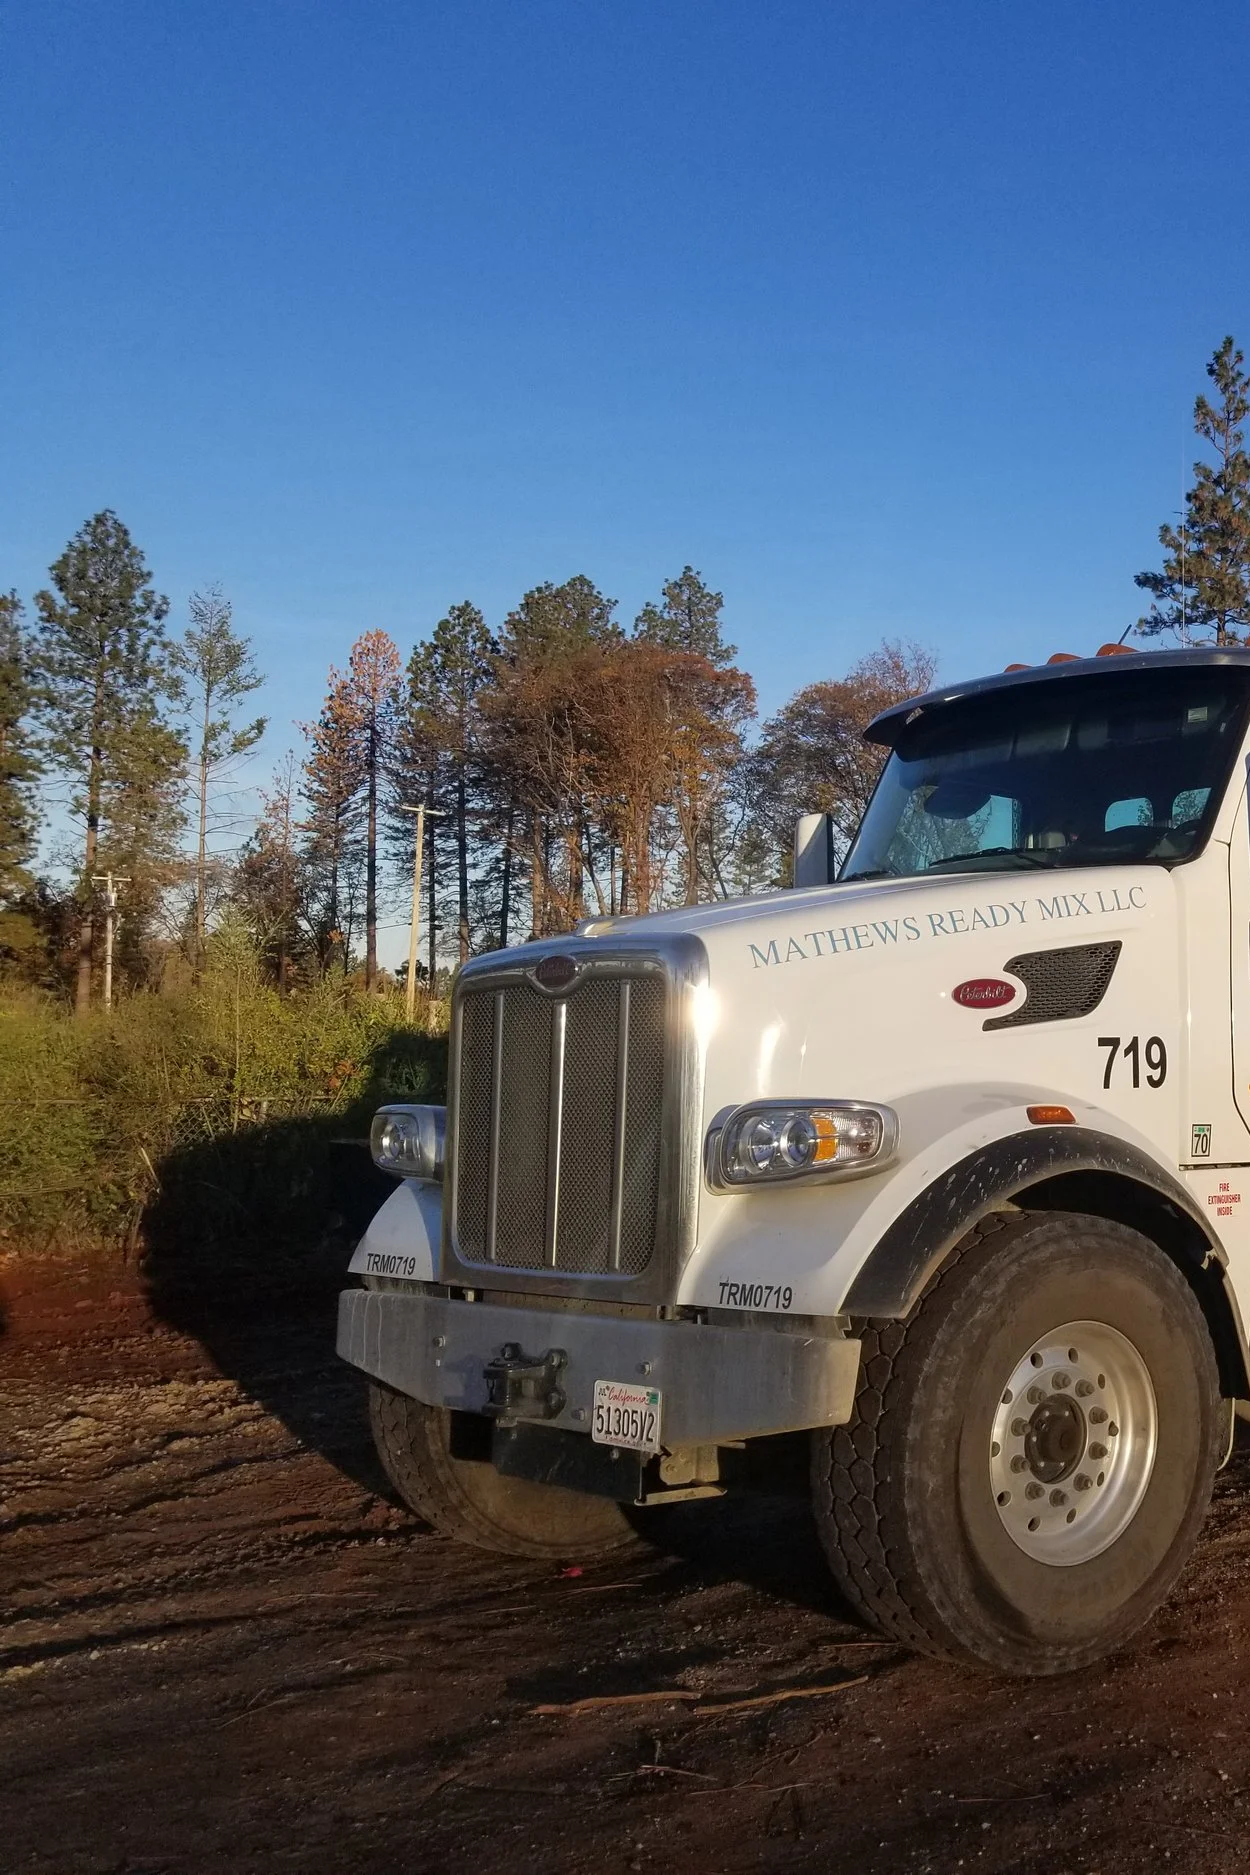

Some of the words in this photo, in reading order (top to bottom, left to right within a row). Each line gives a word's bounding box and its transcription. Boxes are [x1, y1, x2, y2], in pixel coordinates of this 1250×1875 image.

[747, 916, 921, 969] MATHEWS
[925, 900, 1028, 937] READY
[1035, 893, 1093, 921] MIX
[1096, 886, 1147, 913] LLC
[959, 984, 1012, 1003] Peterbilt
[1097, 1036, 1168, 1090] 719
[1194, 1133, 1209, 1154] 70
[1219, 1183, 1230, 1193] FIRE
[1208, 1194, 1241, 1205] EXTINGUISHER
[1216, 1206, 1233, 1217] INSIDE
[366, 1253, 416, 1276] TRM0719
[718, 1281, 793, 1310] TRM0719
[608, 1386, 650, 1407] California
[596, 1404, 655, 1443] 51305V2
